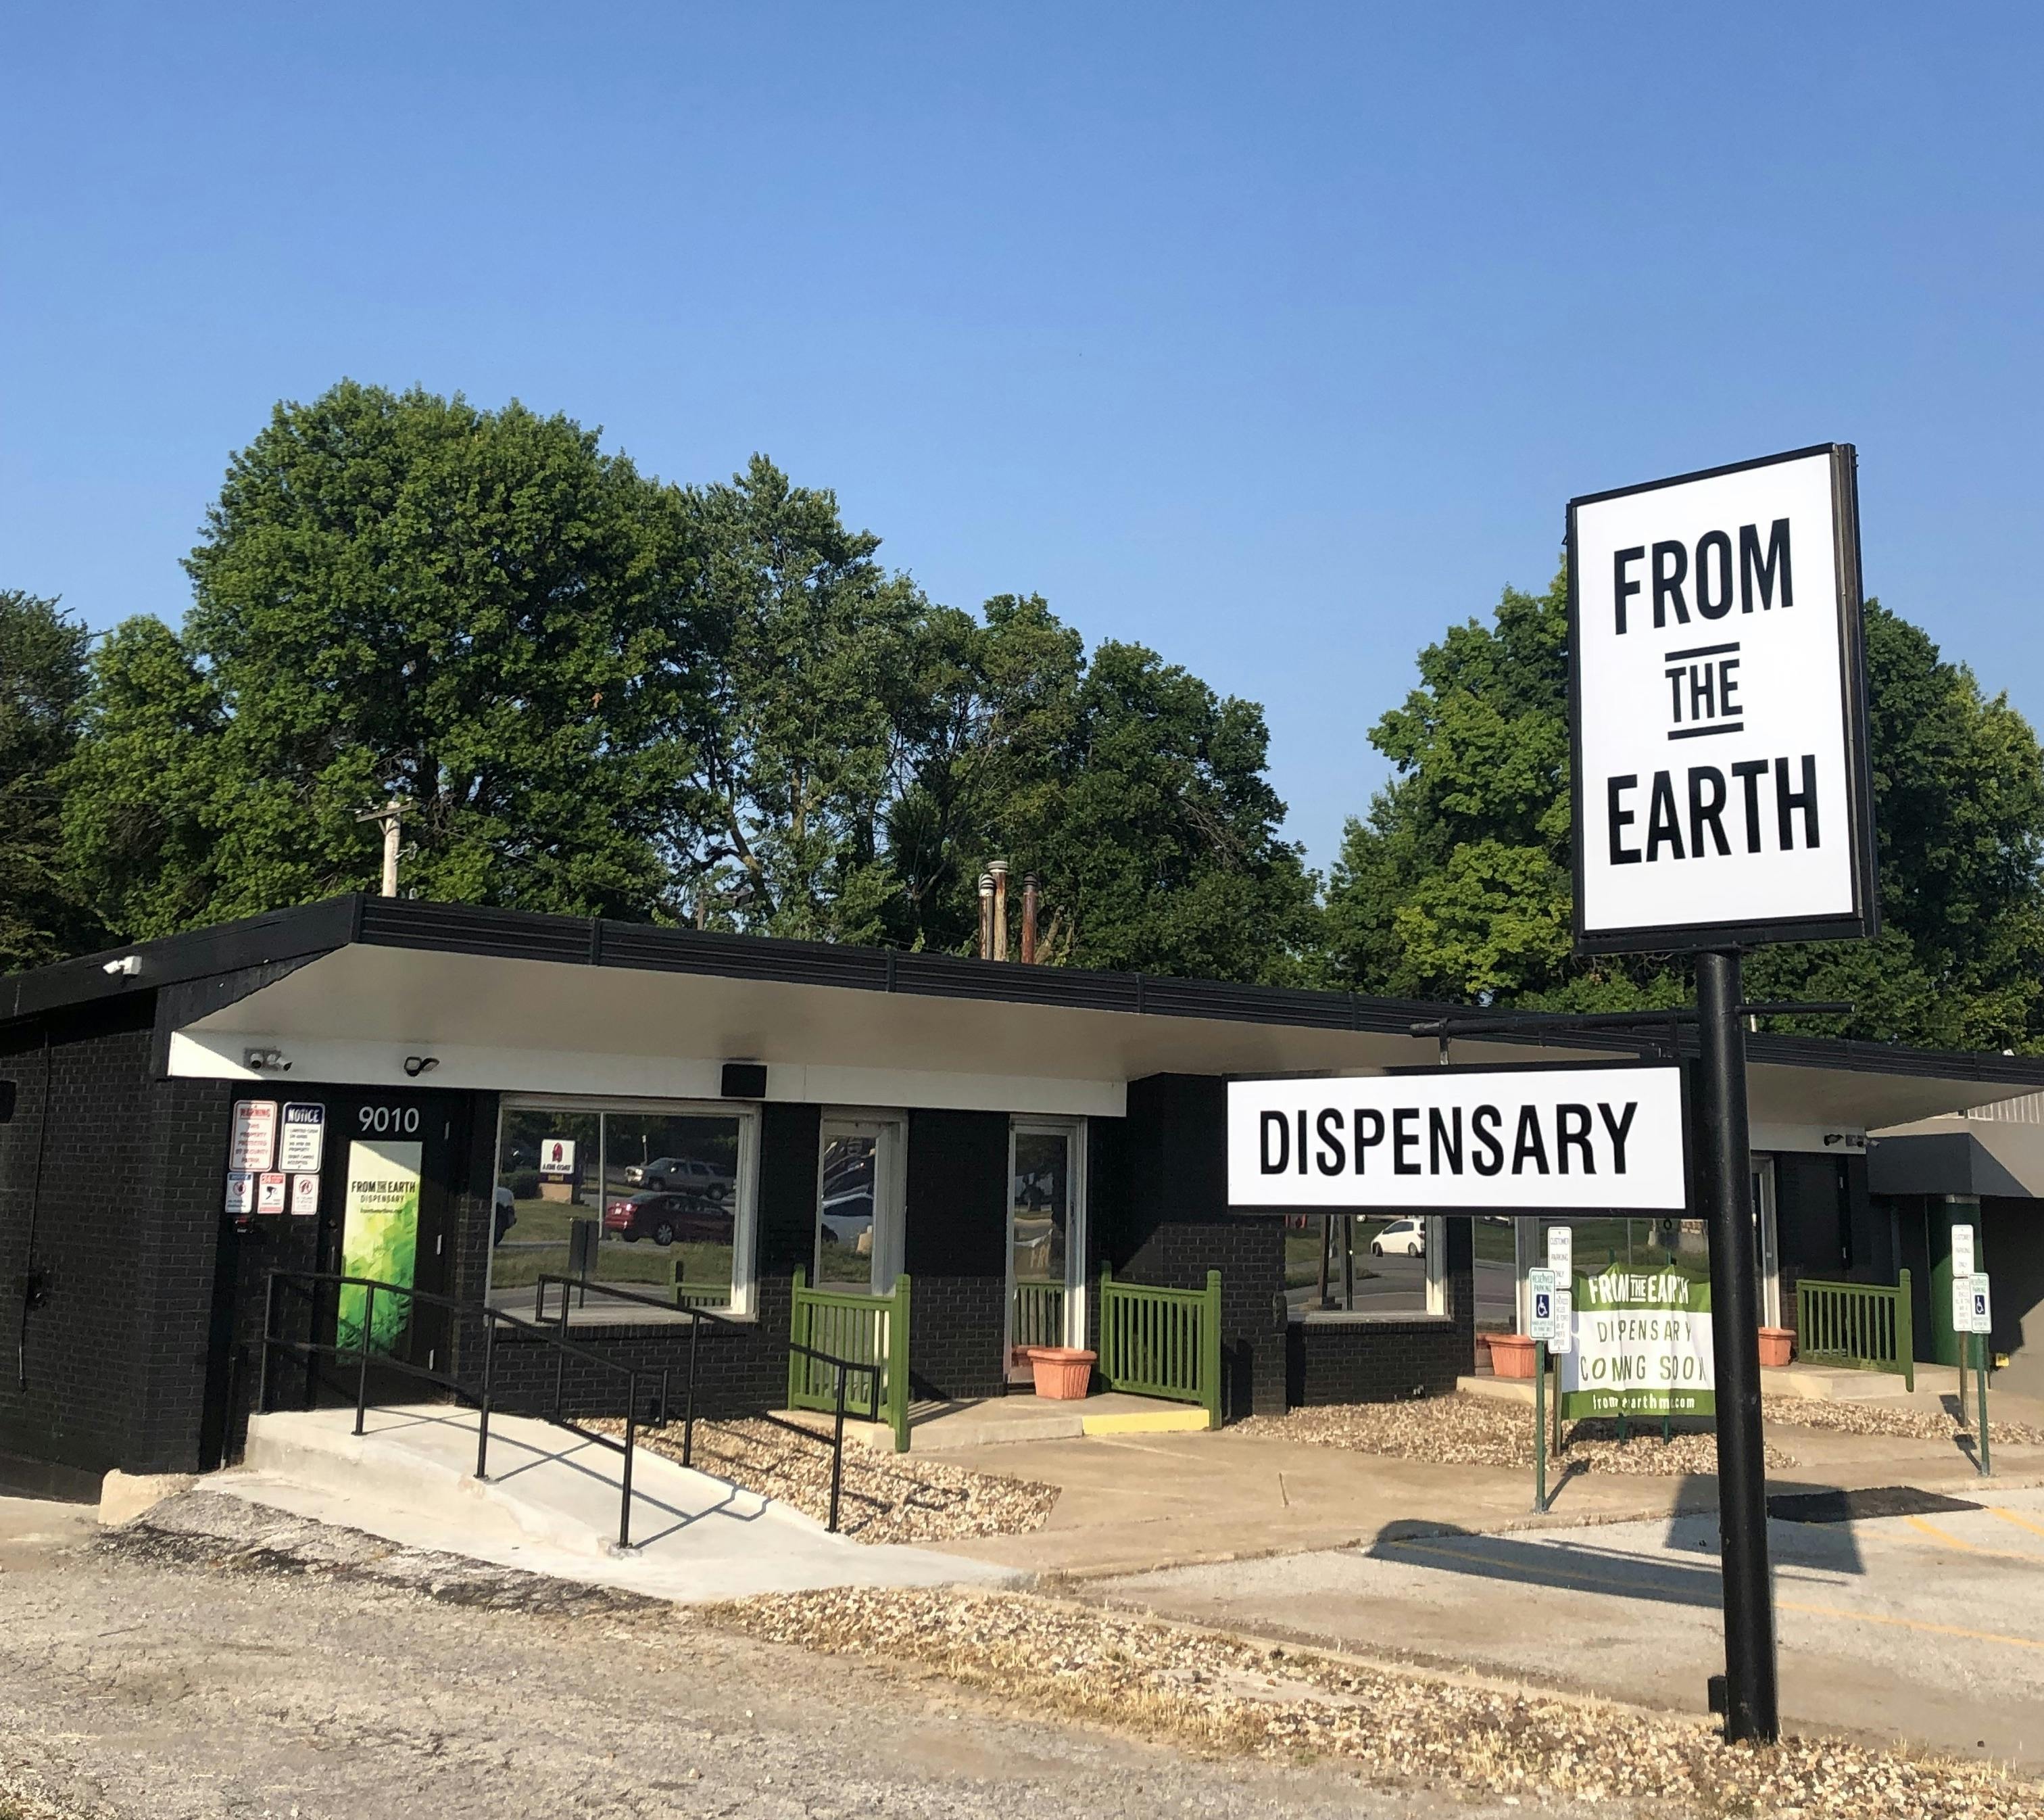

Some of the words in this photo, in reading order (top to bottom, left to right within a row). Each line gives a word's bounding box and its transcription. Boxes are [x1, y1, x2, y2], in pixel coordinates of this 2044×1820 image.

[1613, 518, 1794, 635] FROM
[1665, 658, 1743, 723] THE
[1607, 755, 1820, 865] EARTH
[287, 1108, 320, 1122] NOTICE
[359, 1106, 419, 1132] 9010
[1260, 1101, 1638, 1176] DISPENSARY
[351, 1180, 376, 1193] FROM
[388, 1180, 416, 1193] EARTH
[360, 1195, 405, 1203] DISPENSARY
